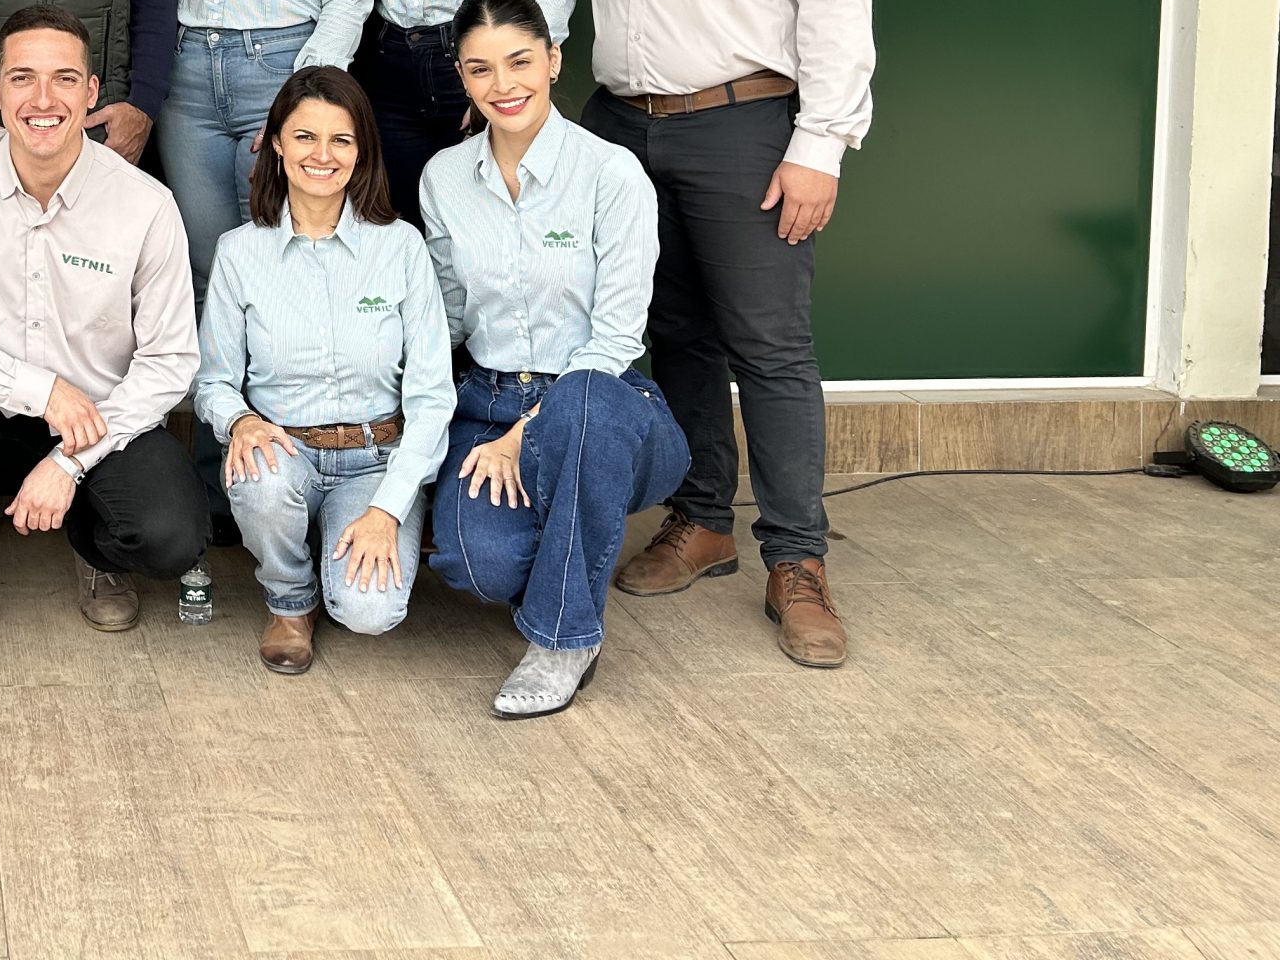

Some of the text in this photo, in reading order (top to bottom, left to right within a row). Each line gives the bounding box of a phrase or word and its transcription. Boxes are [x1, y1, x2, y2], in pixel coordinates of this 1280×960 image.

[542, 240, 578, 248] VETNIL
[62, 253, 113, 274] VETNIL
[356, 304, 392, 313] VETNIL
